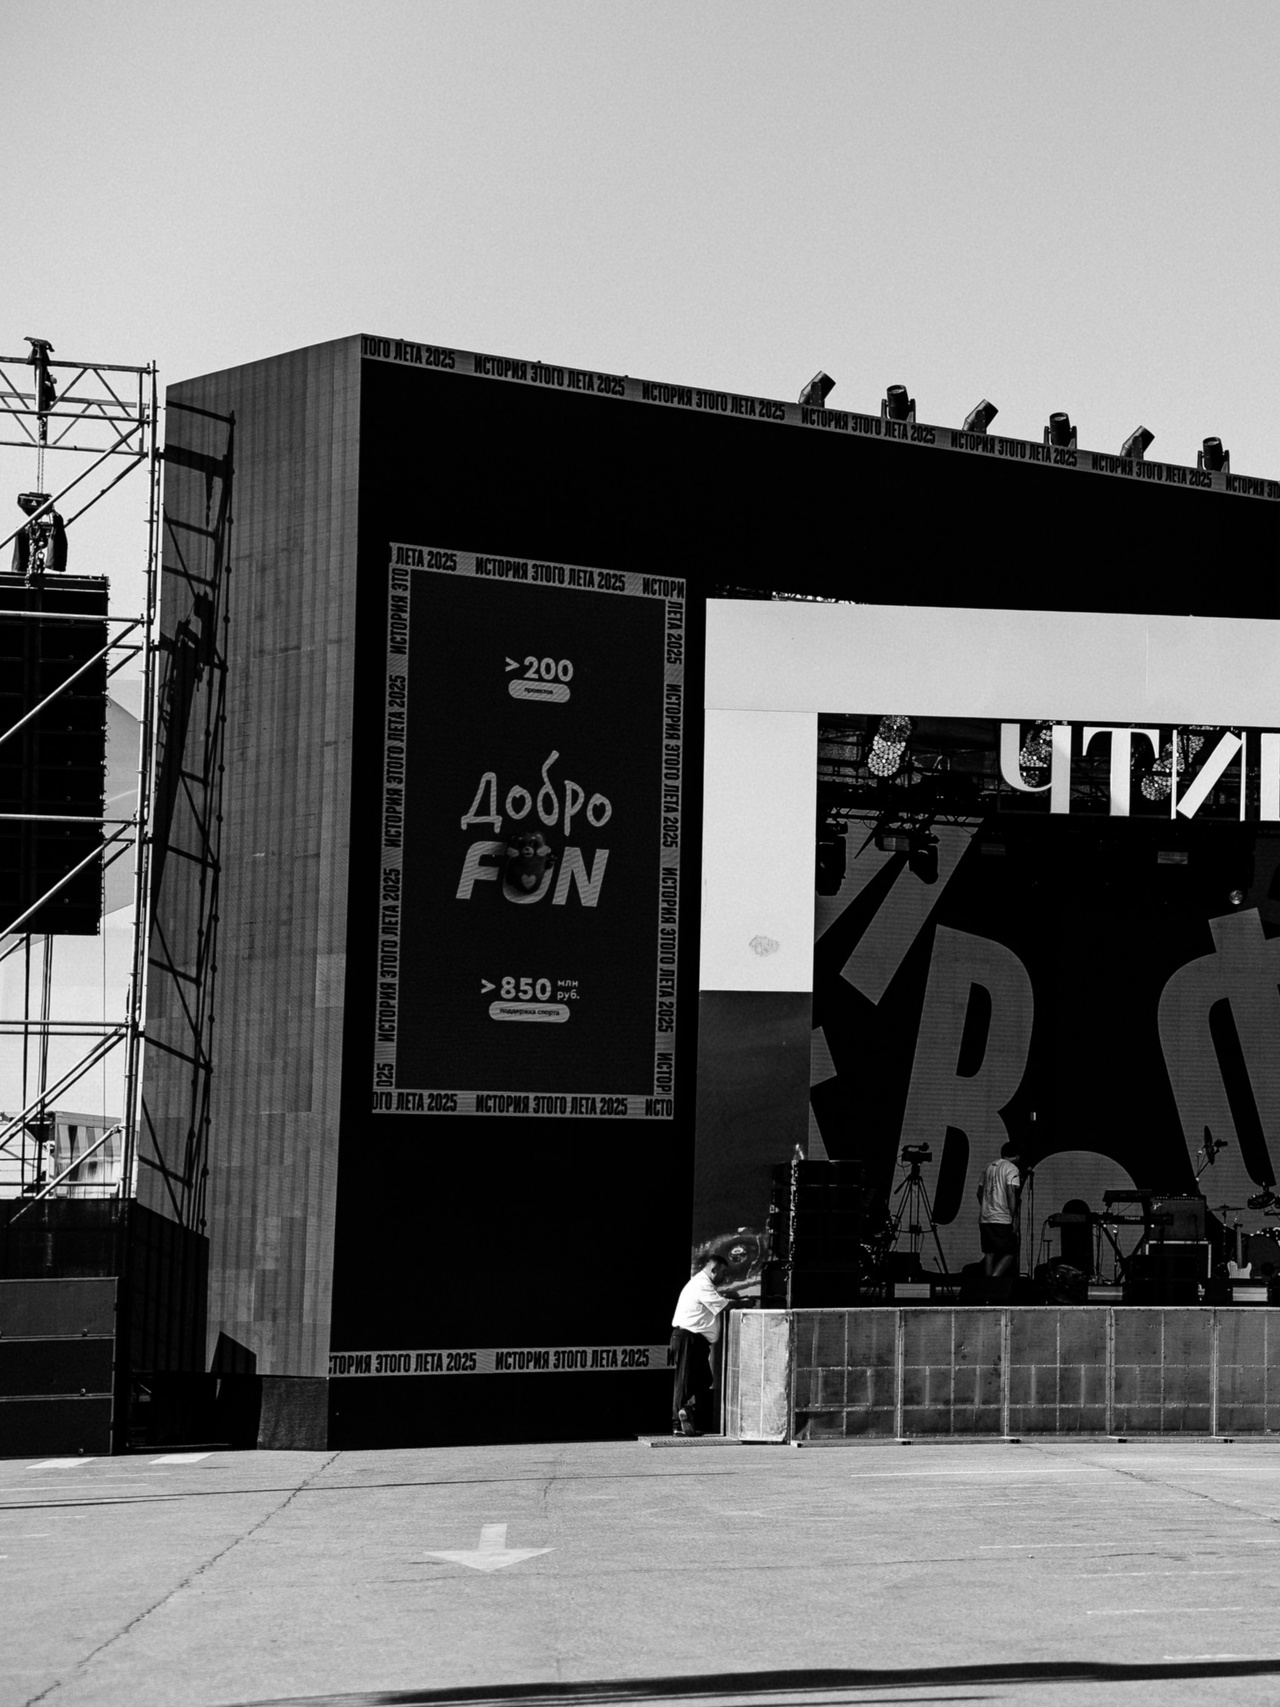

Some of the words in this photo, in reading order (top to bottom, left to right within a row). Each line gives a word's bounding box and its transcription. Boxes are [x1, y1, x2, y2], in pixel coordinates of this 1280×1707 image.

[394, 340, 422, 364] ЛЕТА
[425, 345, 455, 369] 2025
[474, 353, 527, 381] ИСТОРИЯ
[530, 362, 564, 386] ЭТОГО
[567, 368, 594, 391] ЛЕТА
[597, 372, 625, 396] 2025
[642, 380, 692, 406] ИСТОРИЯ
[695, 388, 727, 412] ЭТОГО
[731, 394, 756, 416] ЛЕТА
[758, 398, 785, 420] 2025
[801, 406, 848, 430] ИСТОРИЯ
[851, 413, 881, 436] ЭТОГО
[884, 420, 908, 440] ЛЕТА
[910, 424, 935, 444] 2025
[950, 429, 995, 454] ИСТОРИЯ
[998, 436, 1026, 459] ЭТОГО
[1029, 442, 1051, 463] ЛЕТА
[1053, 447, 1077, 467] 2025
[1091, 452, 1133, 476] ИСТОРИЯ
[1136, 460, 1163, 481] ЭТОГО
[1165, 464, 1187, 484] ЛЕТА
[1189, 468, 1212, 488] 2025
[1225, 474, 1265, 496] ИСТОРИЯ
[391, 567, 409, 591] ЭТО
[396, 546, 424, 567] ЛЕТА
[427, 550, 457, 571] 2025
[475, 556, 528, 580] ИСТОРИЯ
[531, 563, 565, 584] ЭТОГО
[568, 567, 595, 588] ЛЕТА
[597, 571, 625, 592] 2025
[389, 594, 408, 655] ИСТОРИЯ
[667, 600, 683, 630] ЛЕТА
[666, 633, 683, 665] 2025
[388, 674, 406, 708] 2025
[524, 687, 553, 696] проектов
[387, 711, 405, 743] ЛЕТА
[665, 683, 681, 740] ИСТОРИЯ
[386, 745, 404, 784] ЭТОГО
[664, 743, 680, 780] ЭТОГО
[461, 750, 612, 836] Добро
[663, 783, 679, 813] ЛЕТА
[384, 787, 403, 848] ИСТОРИЯ
[662, 816, 679, 848] 2025
[382, 867, 400, 901] 2025
[456, 840, 609, 908] FUN
[660, 867, 677, 924] ИСТОРИЯ
[381, 905, 399, 936] ЛЕТА
[380, 939, 398, 978] ЭТОГО
[659, 928, 676, 964] ЭТОГО
[557, 988, 580, 1001] руб.
[558, 980, 578, 988] млн
[658, 968, 675, 998] ЛЕТА
[377, 982, 397, 1042] ИСТОРИЯ
[537, 1009, 560, 1017] спорта
[657, 1001, 674, 1032] 2025
[395, 1091, 424, 1111] ЛЕТА
[427, 1092, 457, 1112] 2025
[475, 1094, 530, 1113] ИСТОРИЯ
[532, 1095, 567, 1114] ЭТОГО
[569, 1096, 597, 1115] ЛЕТА
[599, 1097, 628, 1116] 2025
[644, 1098, 675, 1117] ИСТО
[375, 1353, 411, 1373] ЭТОГО
[414, 1352, 443, 1372] ЛЕТА
[446, 1352, 477, 1371] 2025
[495, 1350, 549, 1370] ИСТОРИЯ
[553, 1349, 587, 1369] ЭТОГО
[590, 1349, 618, 1368] ЛЕТА
[620, 1348, 649, 1367] 2025
